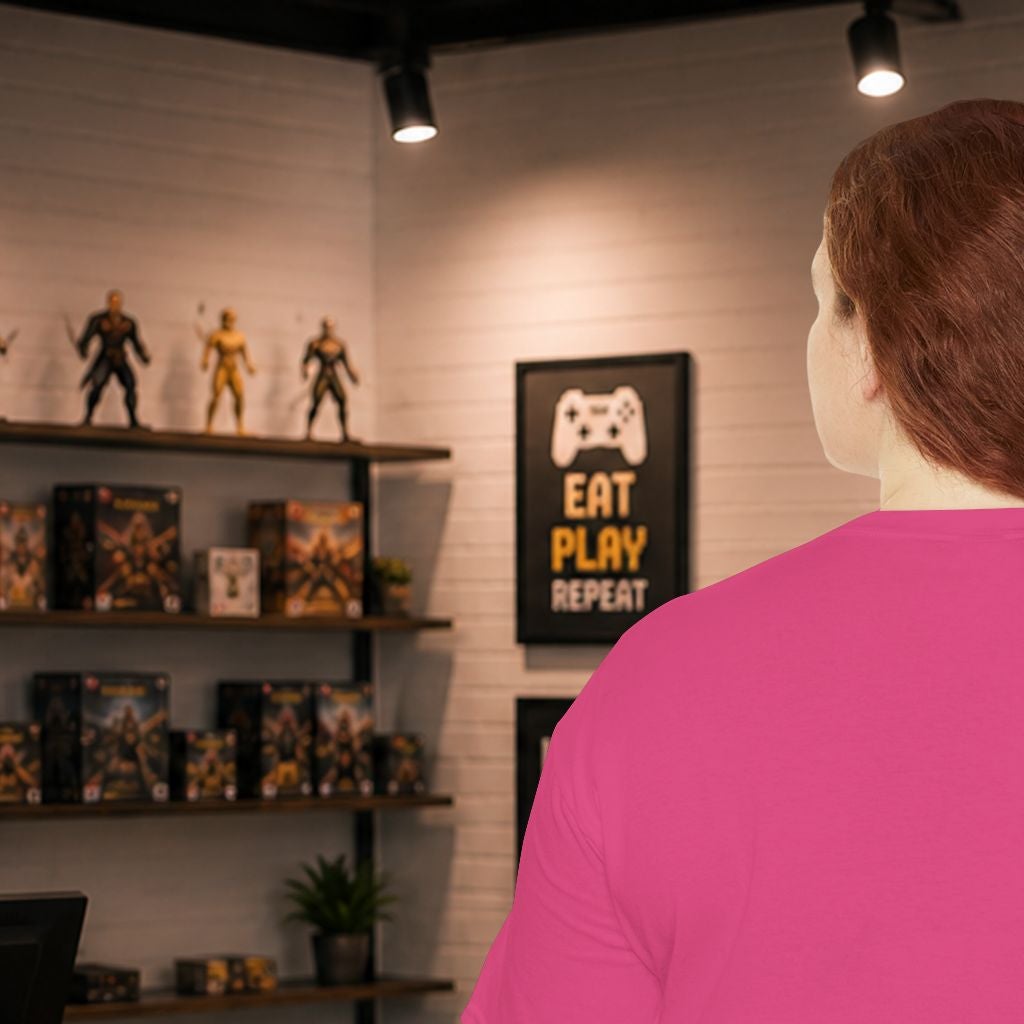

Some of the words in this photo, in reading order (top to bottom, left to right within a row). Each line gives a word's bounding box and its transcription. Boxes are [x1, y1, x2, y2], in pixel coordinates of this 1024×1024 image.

[563, 470, 637, 519] EAT
[551, 525, 648, 573] PLAY
[551, 578, 649, 613] REPEAT
